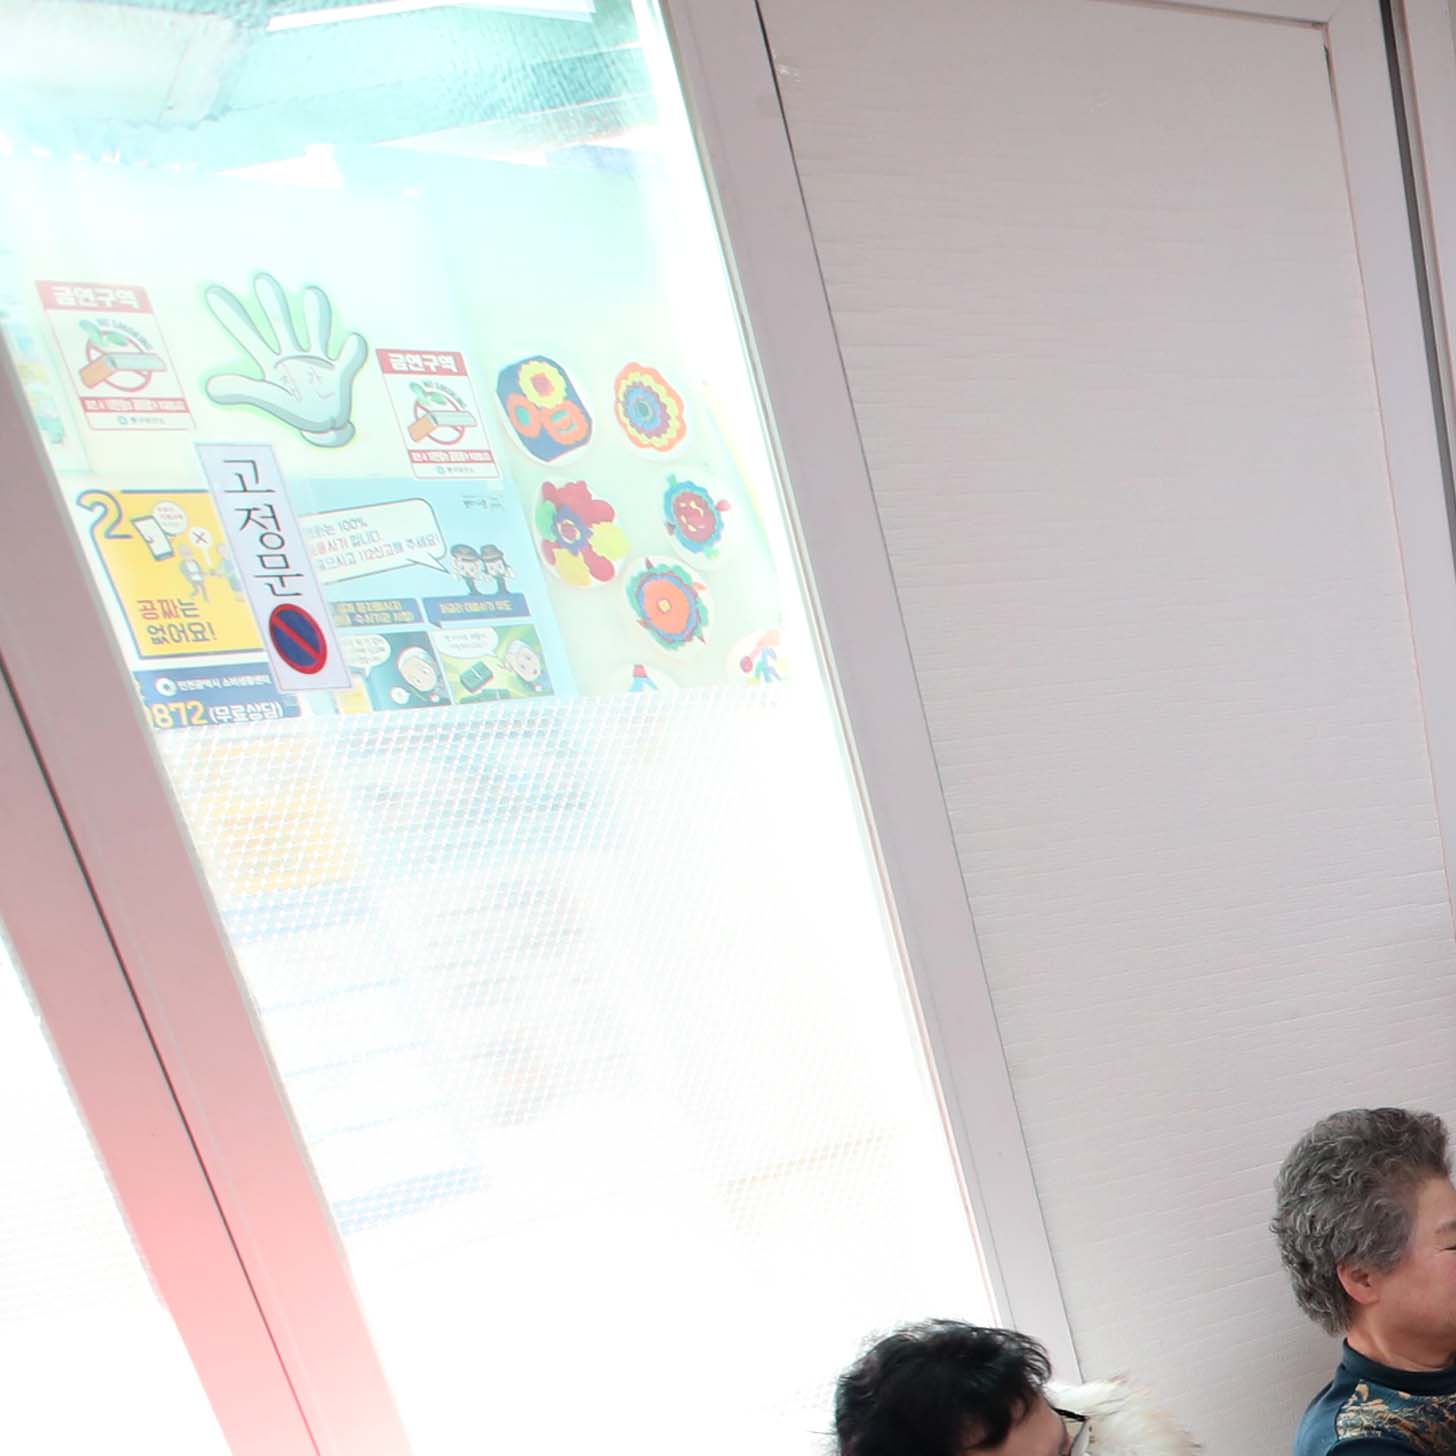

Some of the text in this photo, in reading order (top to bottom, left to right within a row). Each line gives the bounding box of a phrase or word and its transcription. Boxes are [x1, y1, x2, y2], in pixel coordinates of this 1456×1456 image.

[52, 285, 140, 308] 금연구역
[388, 352, 459, 373] 금연구역
[222, 458, 307, 599] 고정문
[136, 598, 201, 621] 공짜는
[147, 622, 218, 646] 없어요!
[208, 702, 284, 724] (무료상담)
